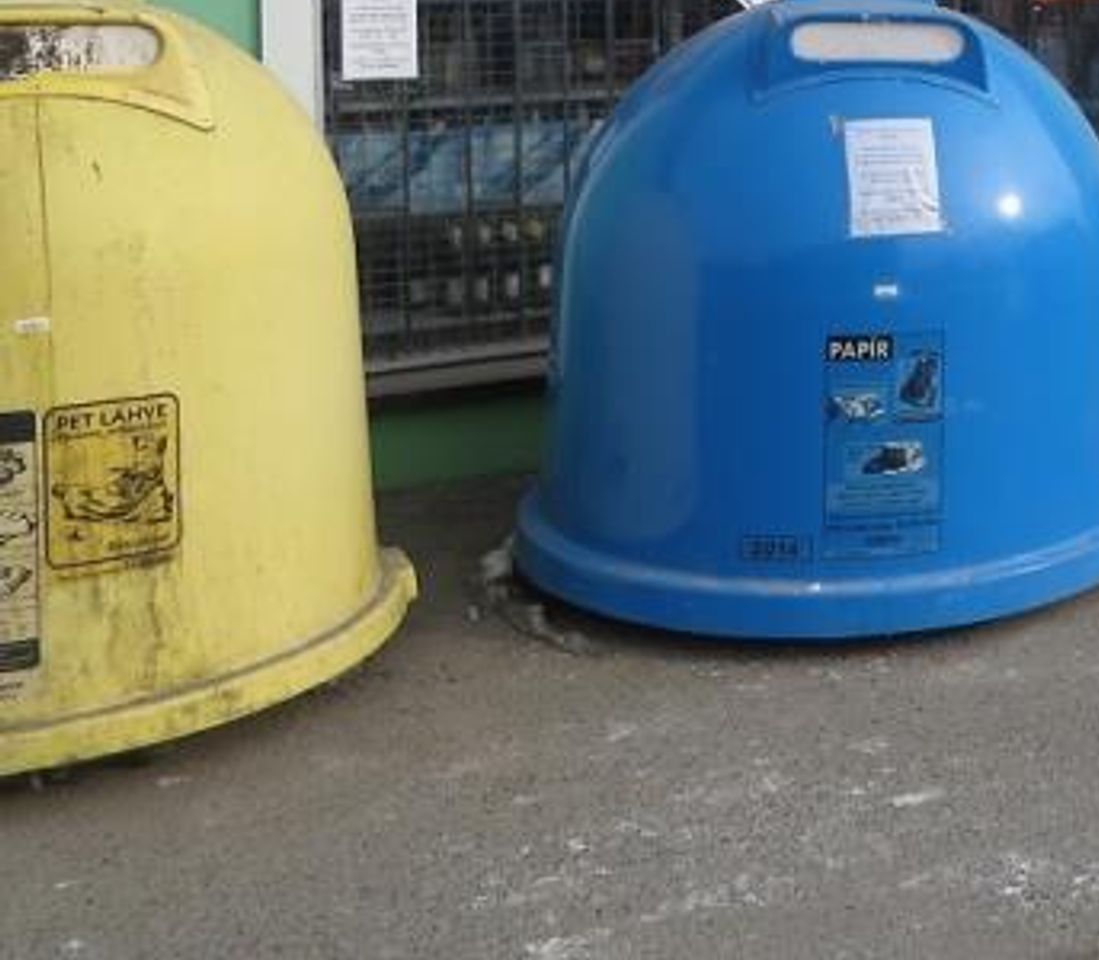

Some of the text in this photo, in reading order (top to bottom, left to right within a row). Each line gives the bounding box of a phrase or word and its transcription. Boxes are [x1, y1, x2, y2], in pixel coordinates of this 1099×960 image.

[829, 337, 889, 360] PAPÍR
[57, 403, 168, 431] PET LAHVE
